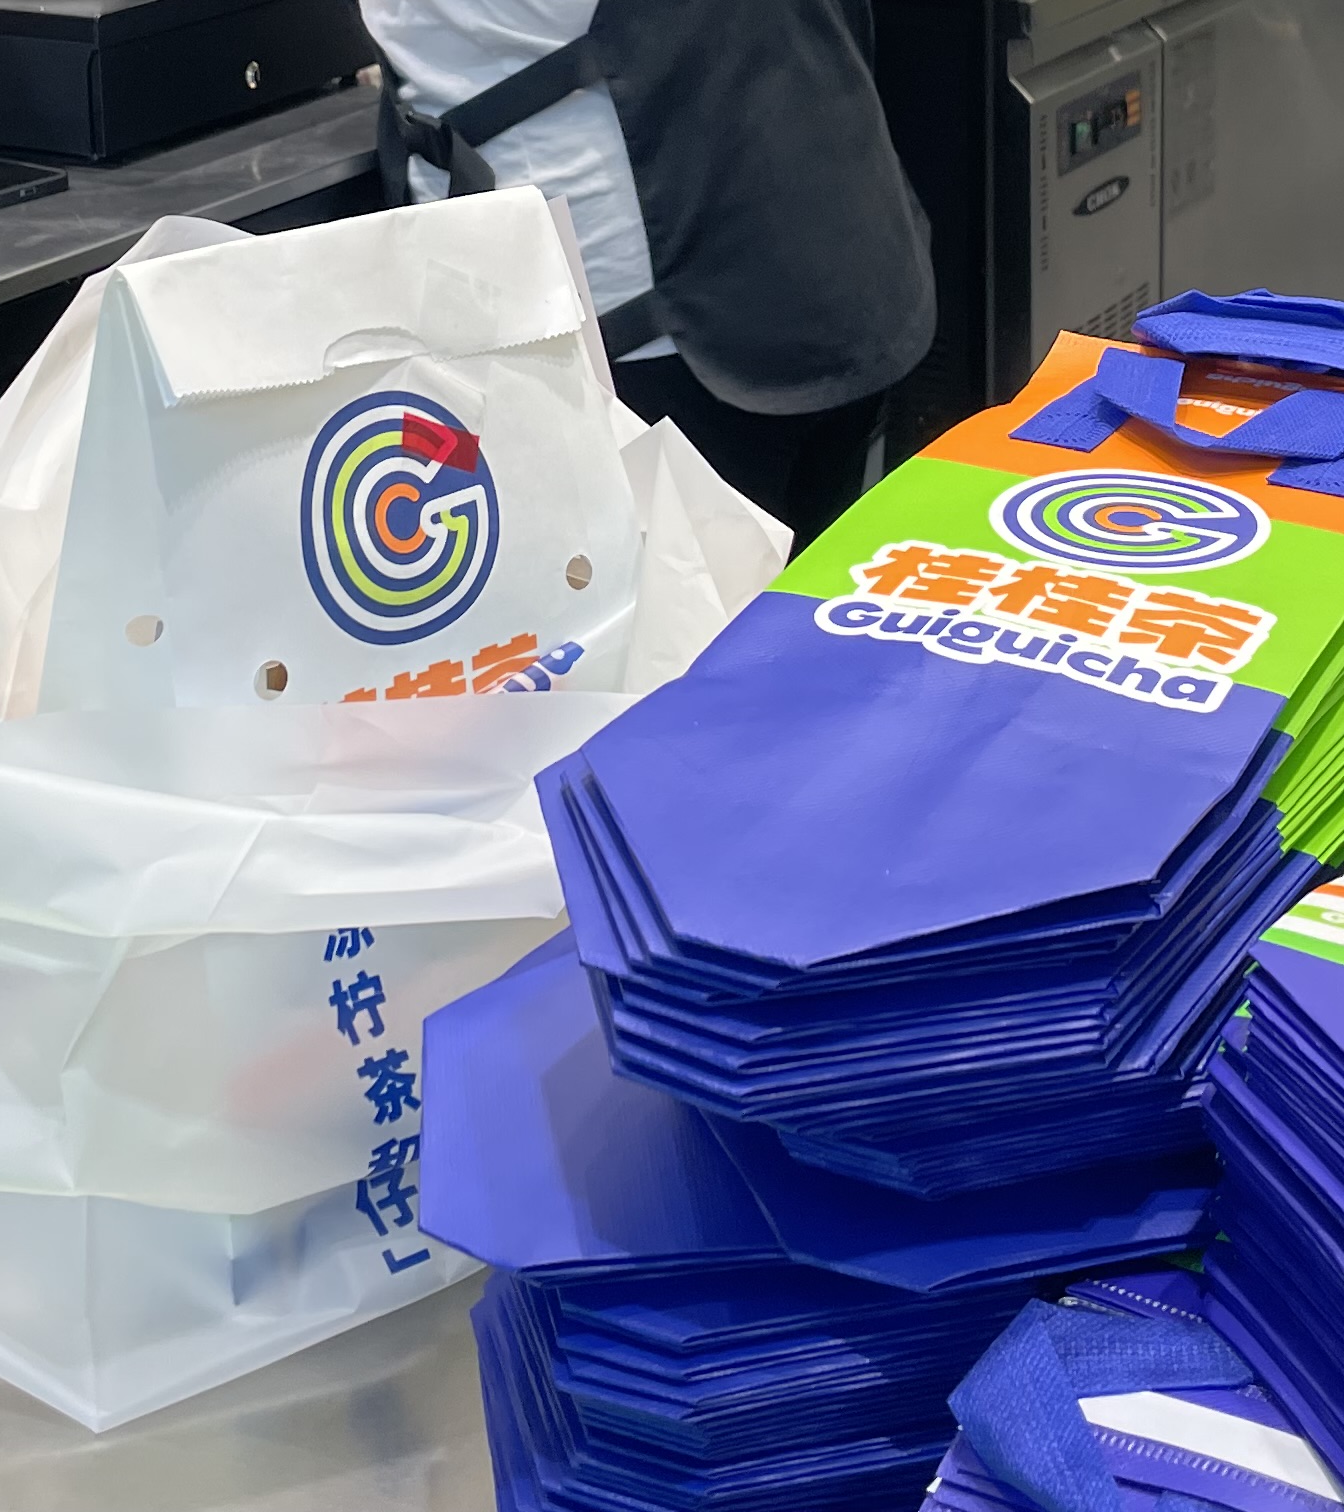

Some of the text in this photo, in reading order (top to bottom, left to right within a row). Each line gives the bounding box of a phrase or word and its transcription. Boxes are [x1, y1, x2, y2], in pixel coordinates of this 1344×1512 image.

[829, 601, 1218, 705] Guiguicha
[863, 545, 1262, 666] 桂桂茶
